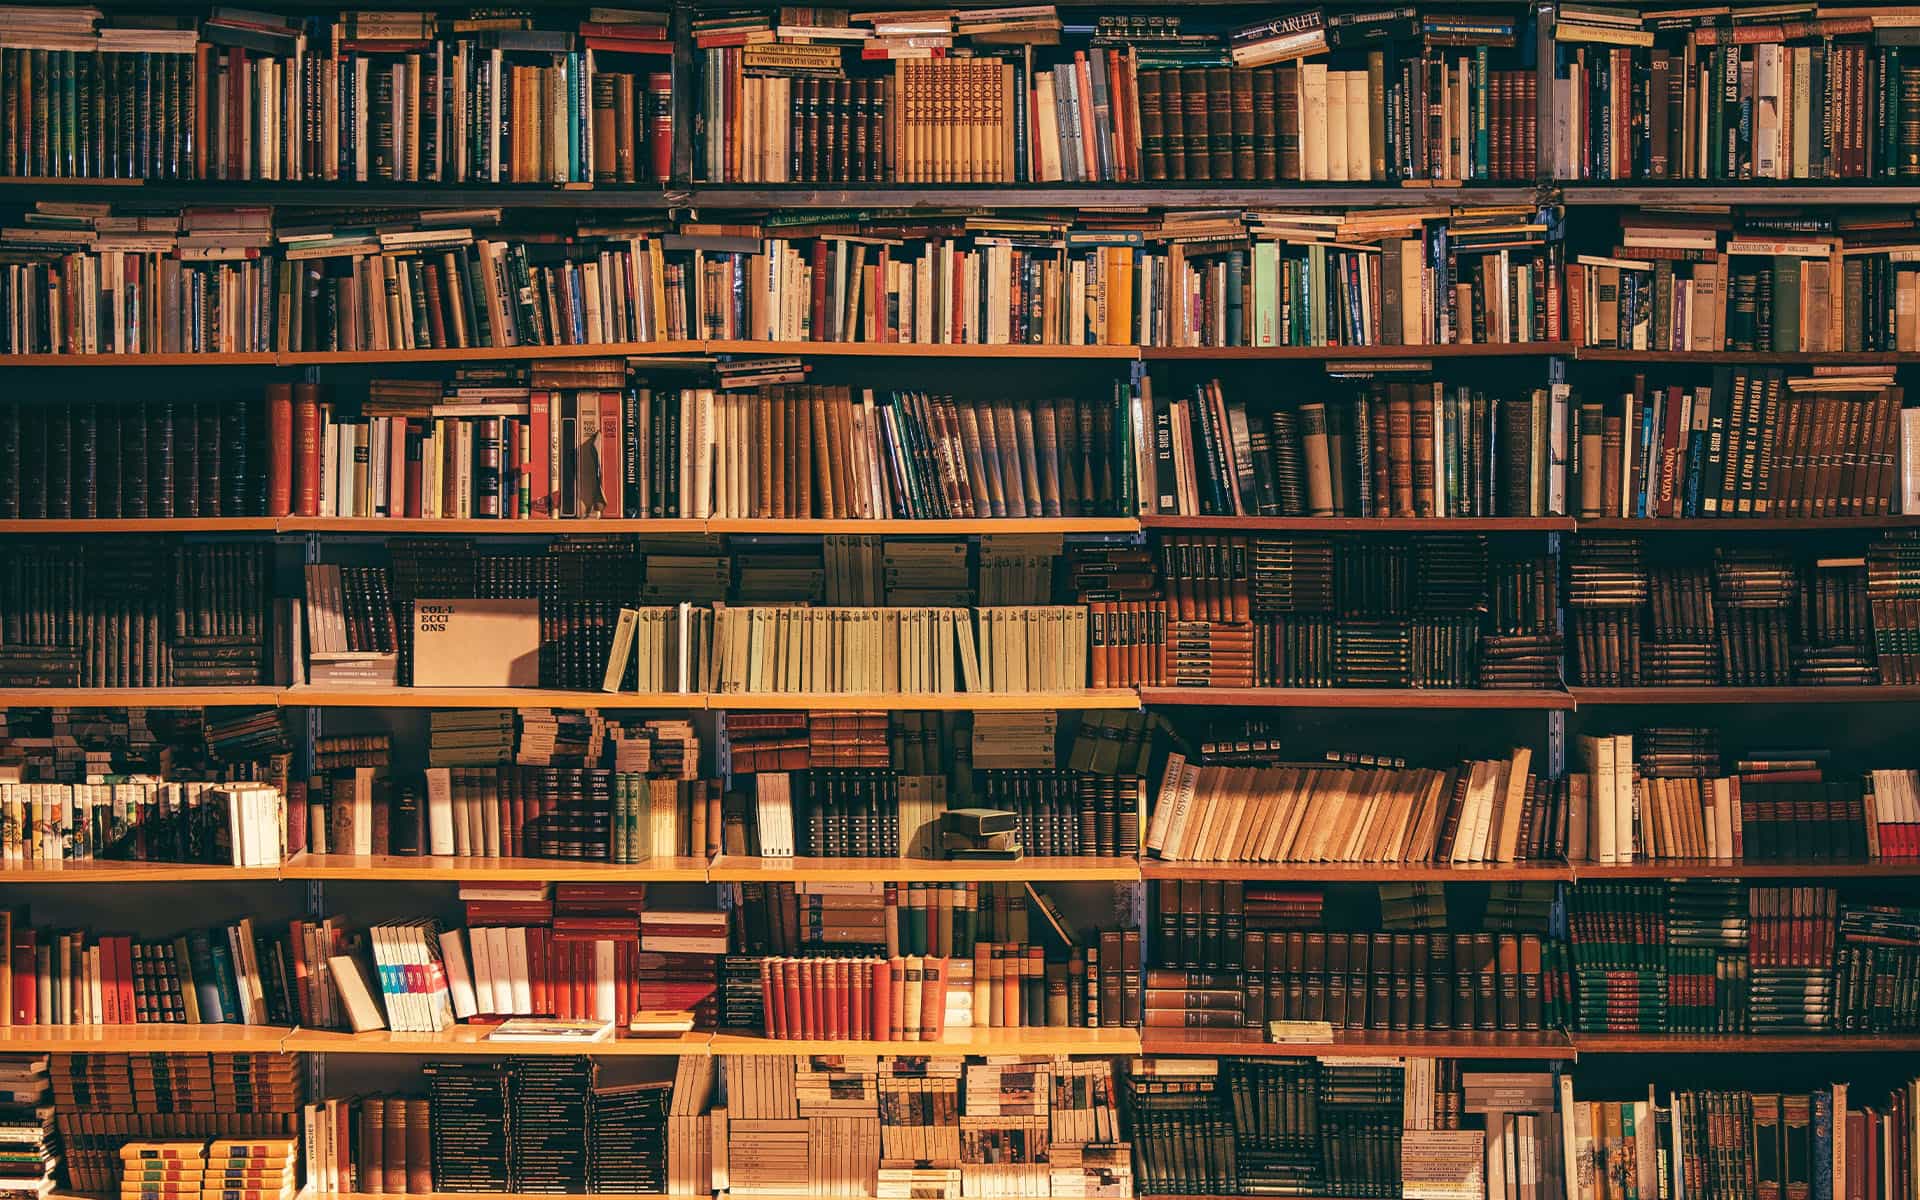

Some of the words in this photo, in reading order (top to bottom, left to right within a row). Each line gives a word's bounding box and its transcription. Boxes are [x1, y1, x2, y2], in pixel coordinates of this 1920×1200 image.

[1268, 10, 1322, 36] SCARLETT
[1726, 47, 1738, 85] CIENCIAS
[904, 64, 914, 127] BRICOLAJE
[915, 64, 924, 127] BRICOLAJE
[924, 64, 933, 127] BRICOLAJE
[933, 64, 942, 127] BRICOLAJE
[942, 64, 951, 127] BRICOLAJE
[952, 64, 961, 127] BRICOLAJE
[961, 64, 971, 127] BRICOLAJE
[972, 64, 982, 127] BRICOLAJE
[982, 64, 992, 127] BRICOLAJE
[992, 64, 1002, 127] BRICOLAJE
[1726, 86, 1737, 102] LAS
[1158, 414, 1168, 425] XX
[1158, 429, 1169, 448] SIGLO
[1711, 417, 1723, 428] XX
[1746, 426, 1758, 436] LA
[1159, 450, 1170, 459] EL
[1709, 454, 1720, 463] EL
[1710, 432, 1722, 452] SIGLO
[1723, 430, 1741, 491] CIVILIZACIONES
[1745, 440, 1756, 450] DE
[1661, 447, 1675, 502] CATALONIA
[1741, 481, 1752, 490] LA
[420, 614, 449, 623] ECCI
[420, 623, 446, 632] ONS
[1160, 759, 1181, 808] PARNASO
